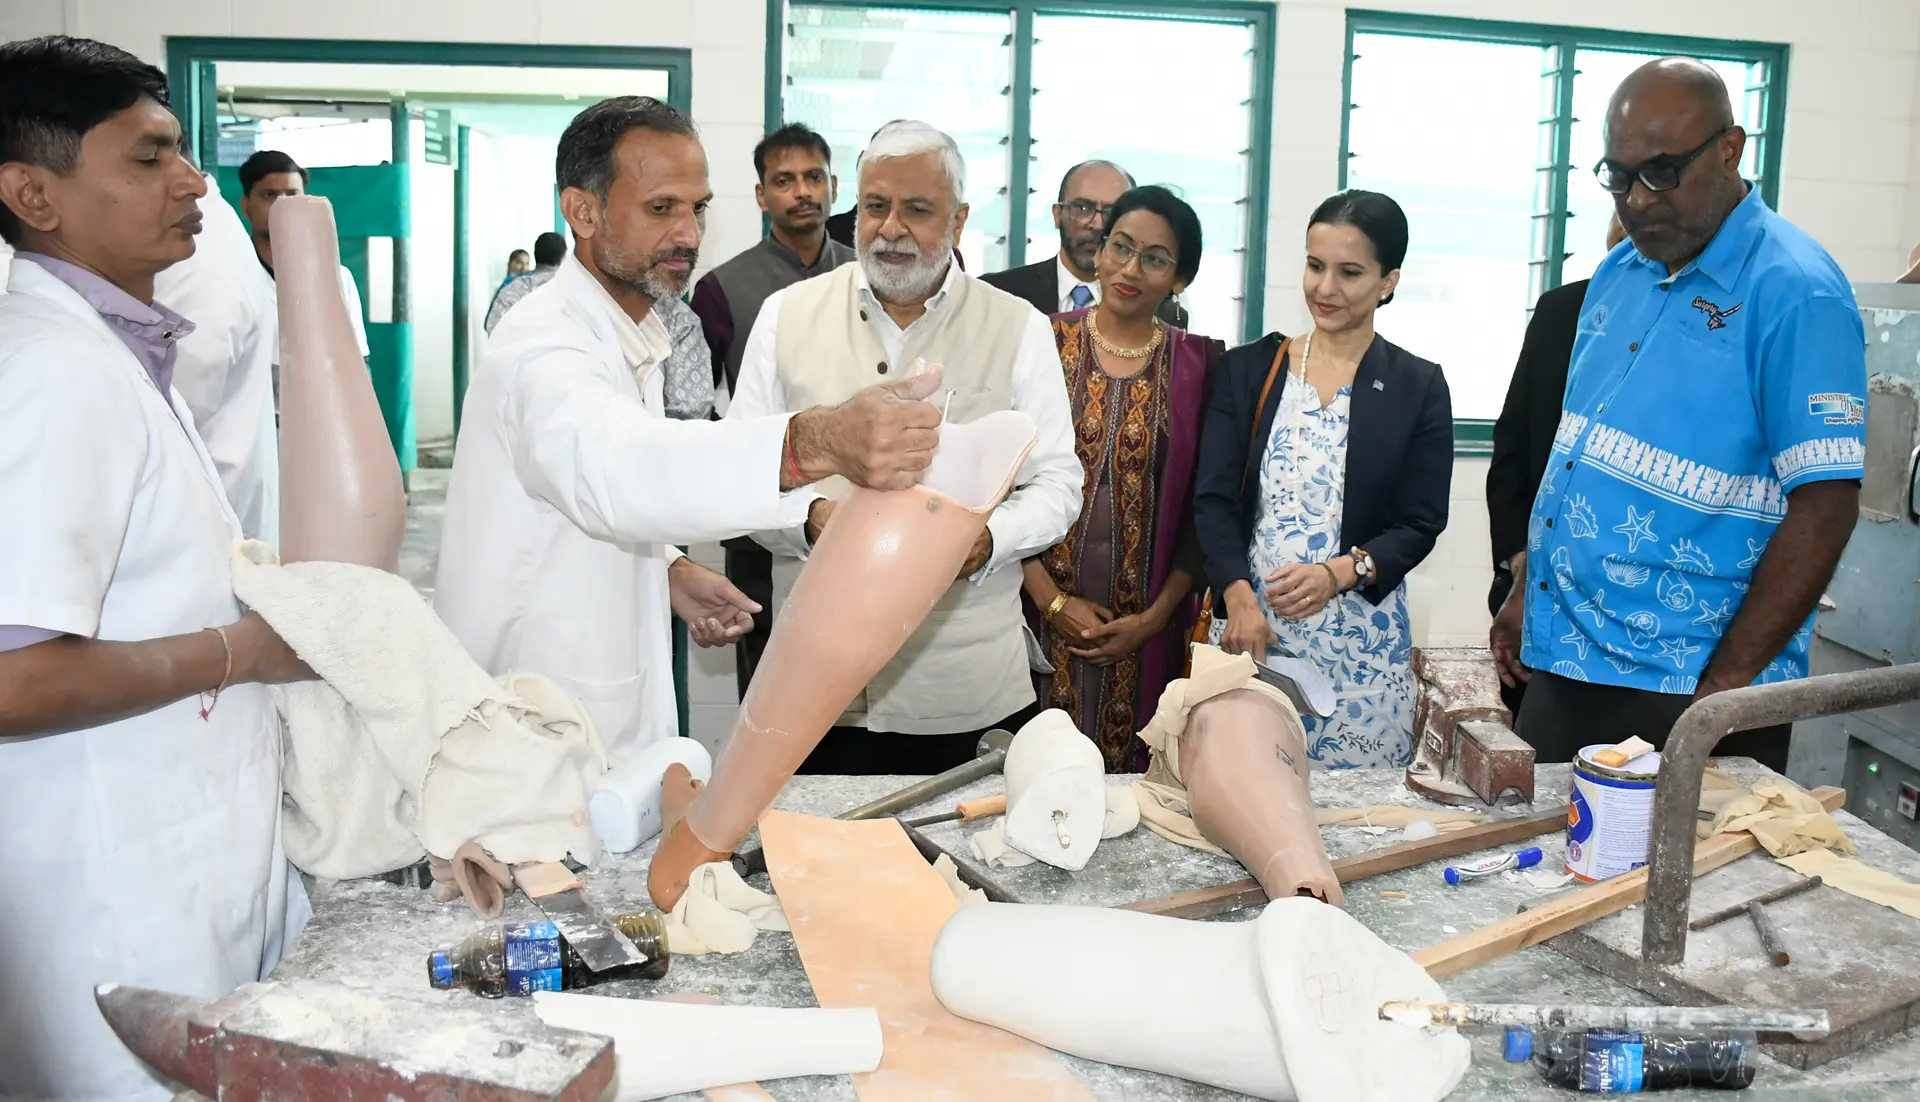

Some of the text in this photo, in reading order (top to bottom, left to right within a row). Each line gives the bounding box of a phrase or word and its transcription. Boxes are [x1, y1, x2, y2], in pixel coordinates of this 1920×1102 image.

[1692, 297, 1719, 316] Surgery
[1810, 394, 1846, 402] MINISTRY
[1477, 860, 1501, 870] marker
[1598, 1048, 1612, 1093] quaSafe
